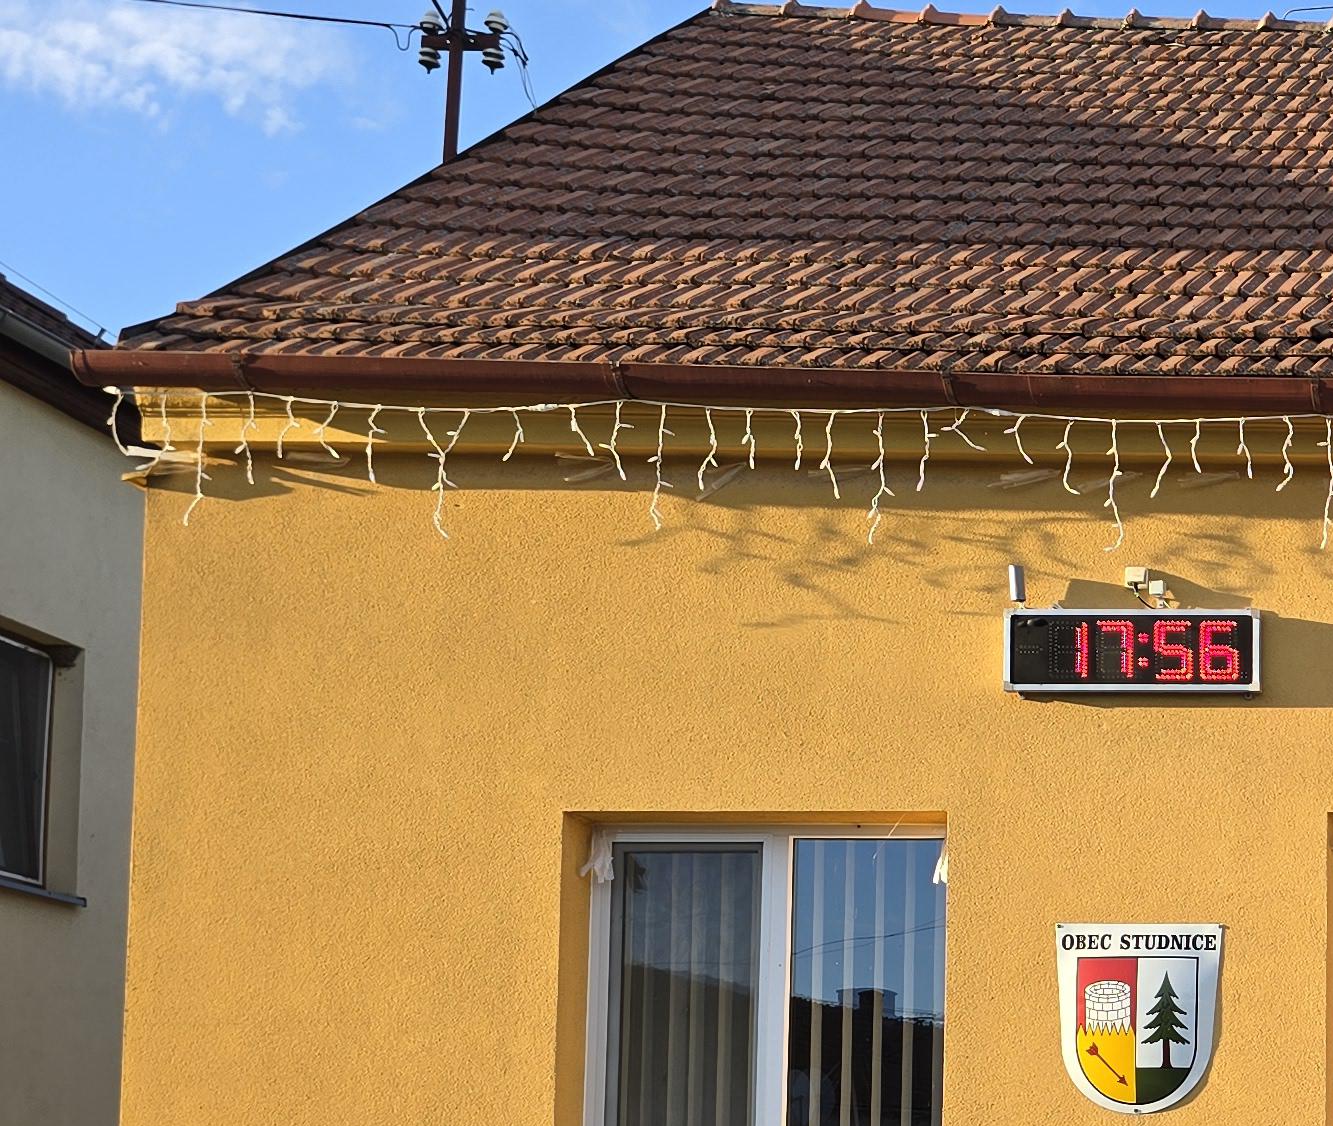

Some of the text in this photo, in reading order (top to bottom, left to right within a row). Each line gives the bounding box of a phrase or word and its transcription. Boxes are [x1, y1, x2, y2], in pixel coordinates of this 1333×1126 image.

[1074, 620, 1240, 679] 17:56
[1062, 934, 1217, 950] OBEC STUDNICE
